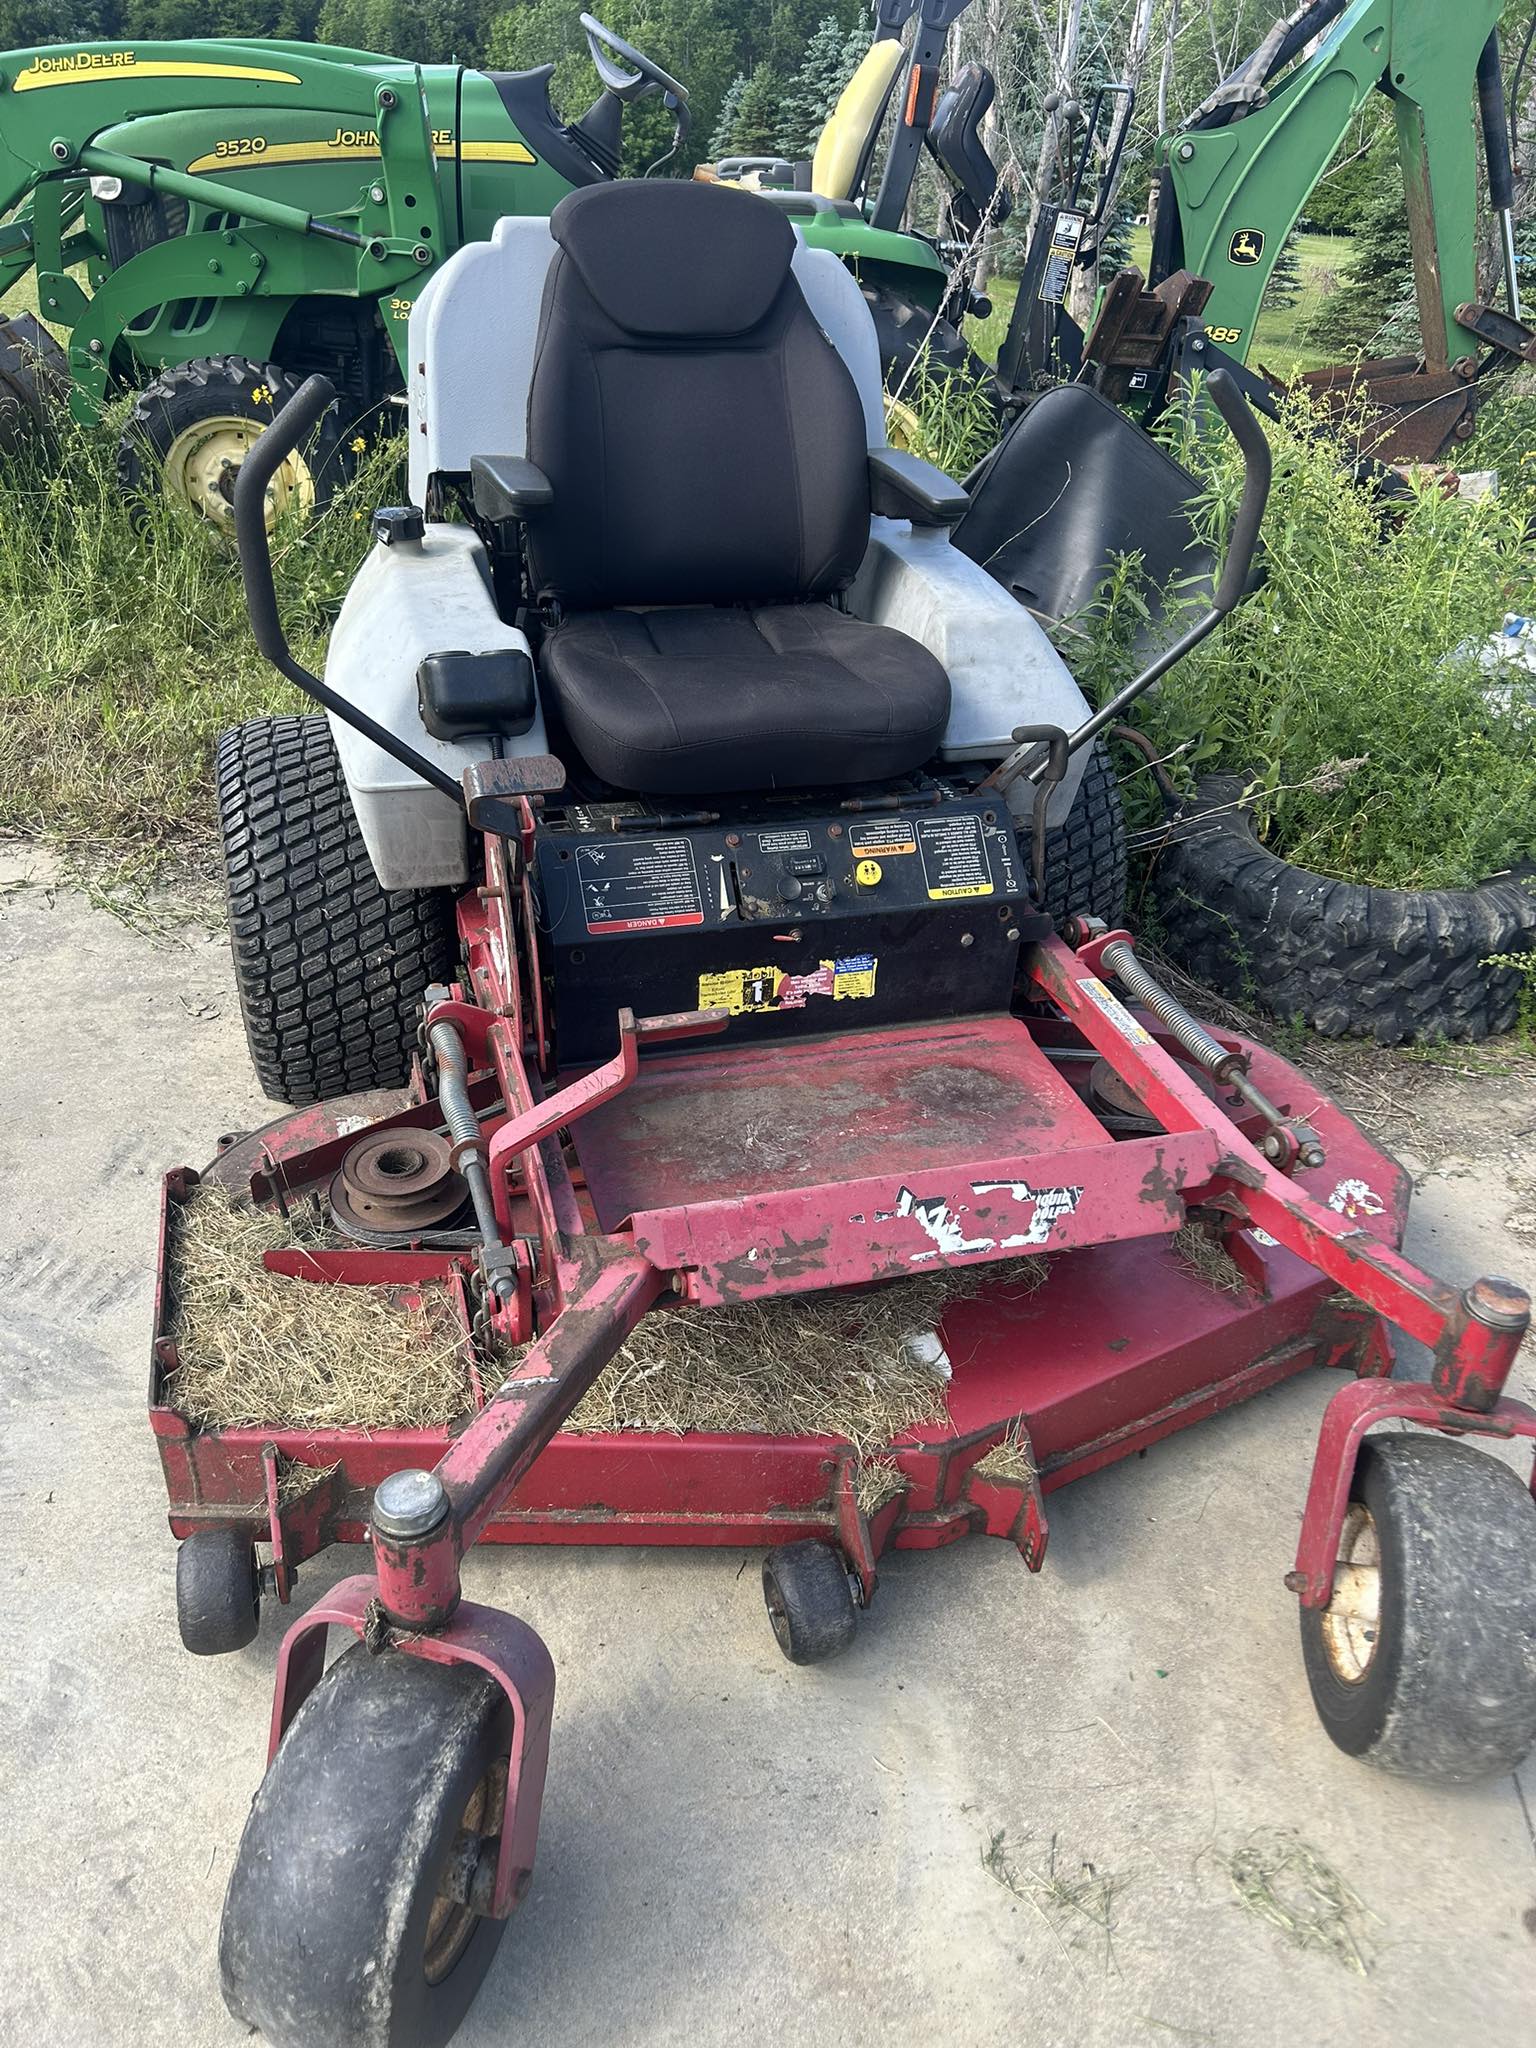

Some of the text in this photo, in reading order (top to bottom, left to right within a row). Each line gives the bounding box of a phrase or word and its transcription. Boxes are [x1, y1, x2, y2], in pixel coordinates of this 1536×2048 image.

[28, 51, 136, 74] JOHN DEERE
[215, 136, 267, 158] 3520
[1203, 325, 1242, 344] 485
[864, 845, 897, 855] WARNING
[942, 887, 973, 897] CAUTION
[626, 919, 657, 929] DANGER
